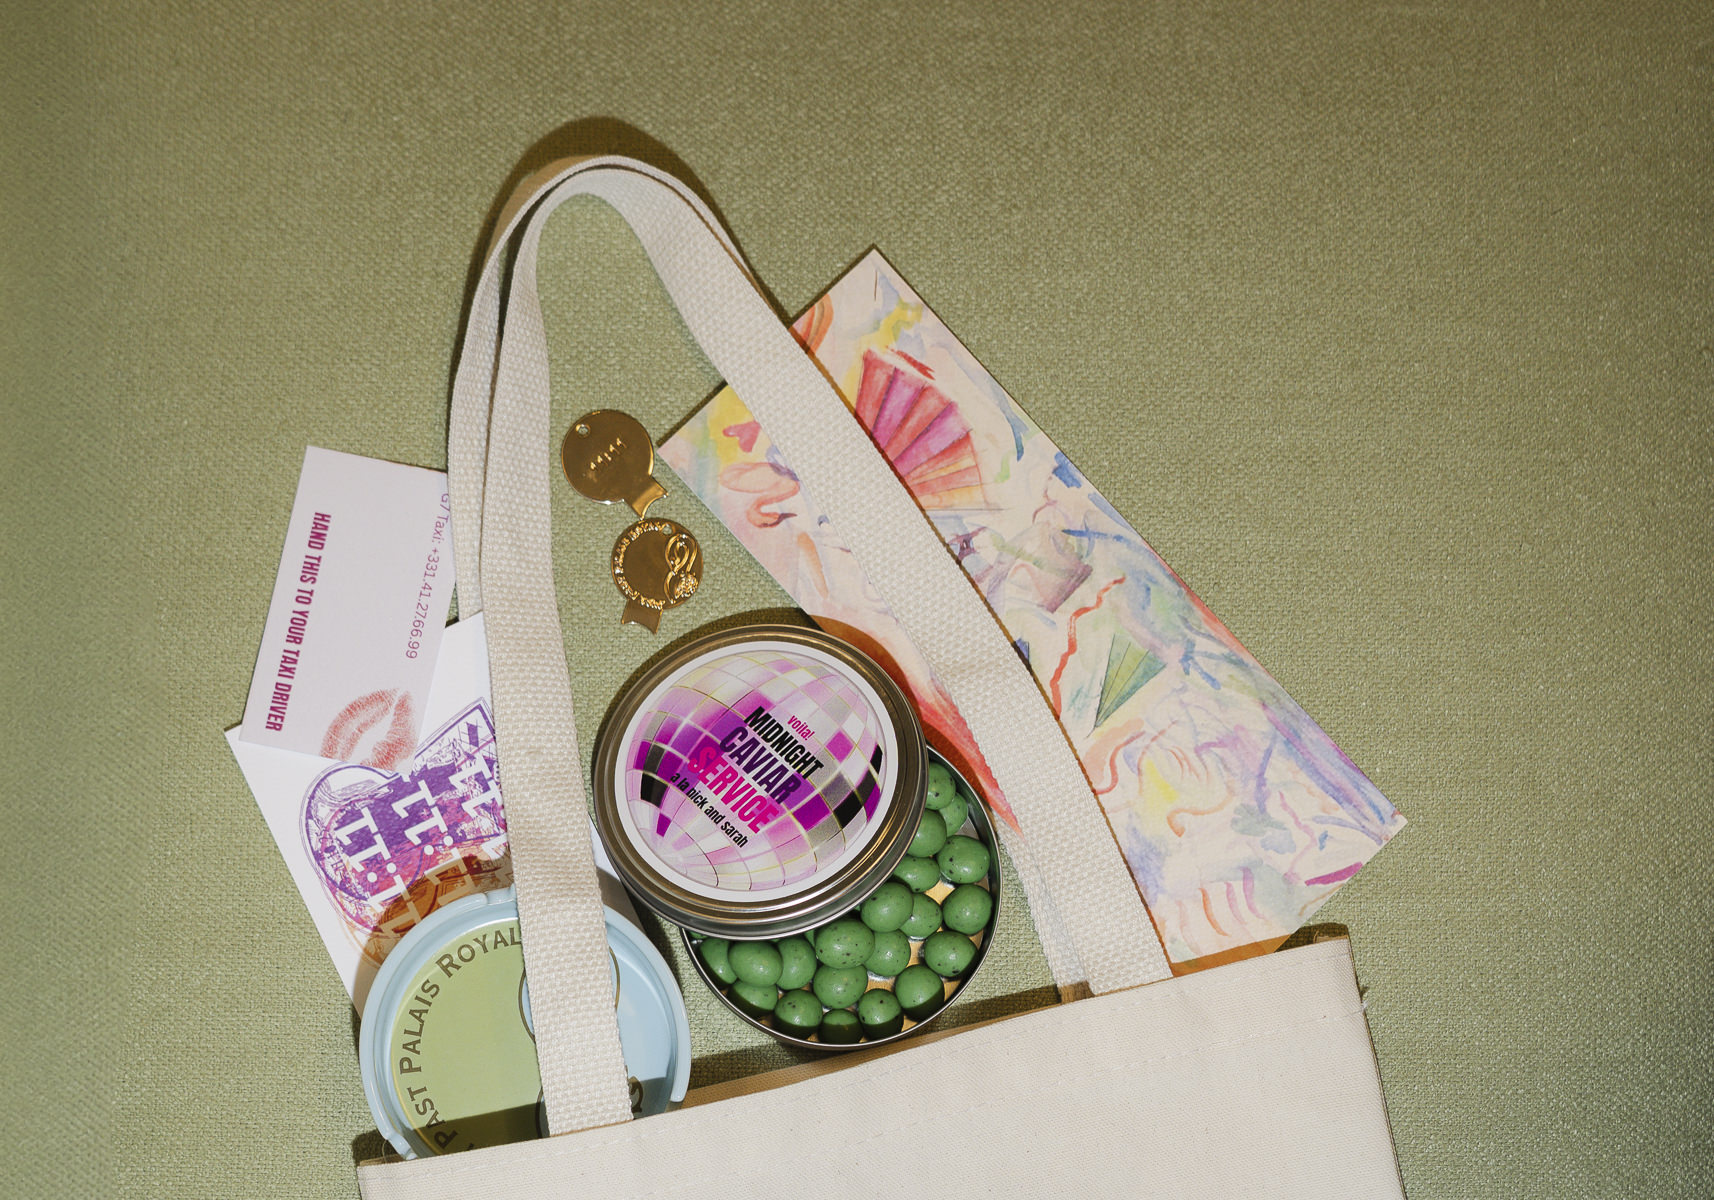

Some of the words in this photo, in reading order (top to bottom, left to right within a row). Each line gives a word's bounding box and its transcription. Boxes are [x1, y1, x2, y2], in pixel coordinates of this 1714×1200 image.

[308, 511, 331, 550] HAND
[431, 515, 449, 544] Taxi:
[299, 554, 322, 584] THIS
[295, 588, 314, 606] TO
[286, 609, 309, 645] YOUR
[277, 648, 300, 679] TAXI
[265, 681, 292, 732] DRIVER
[787, 714, 816, 742] voila!
[719, 726, 802, 804] CAVIAR
[744, 705, 824, 780] MIDNIGHT
[669, 772, 681, 783] a
[677, 777, 690, 792] la
[685, 787, 708, 810] nick
[703, 805, 726, 826] and
[720, 820, 749, 849] sarah
[687, 746, 780, 834] SERVICE
[435, 927, 521, 979] ROYAL
[398, 978, 441, 1075] PALAIS
[406, 1085, 459, 1150] PAST
